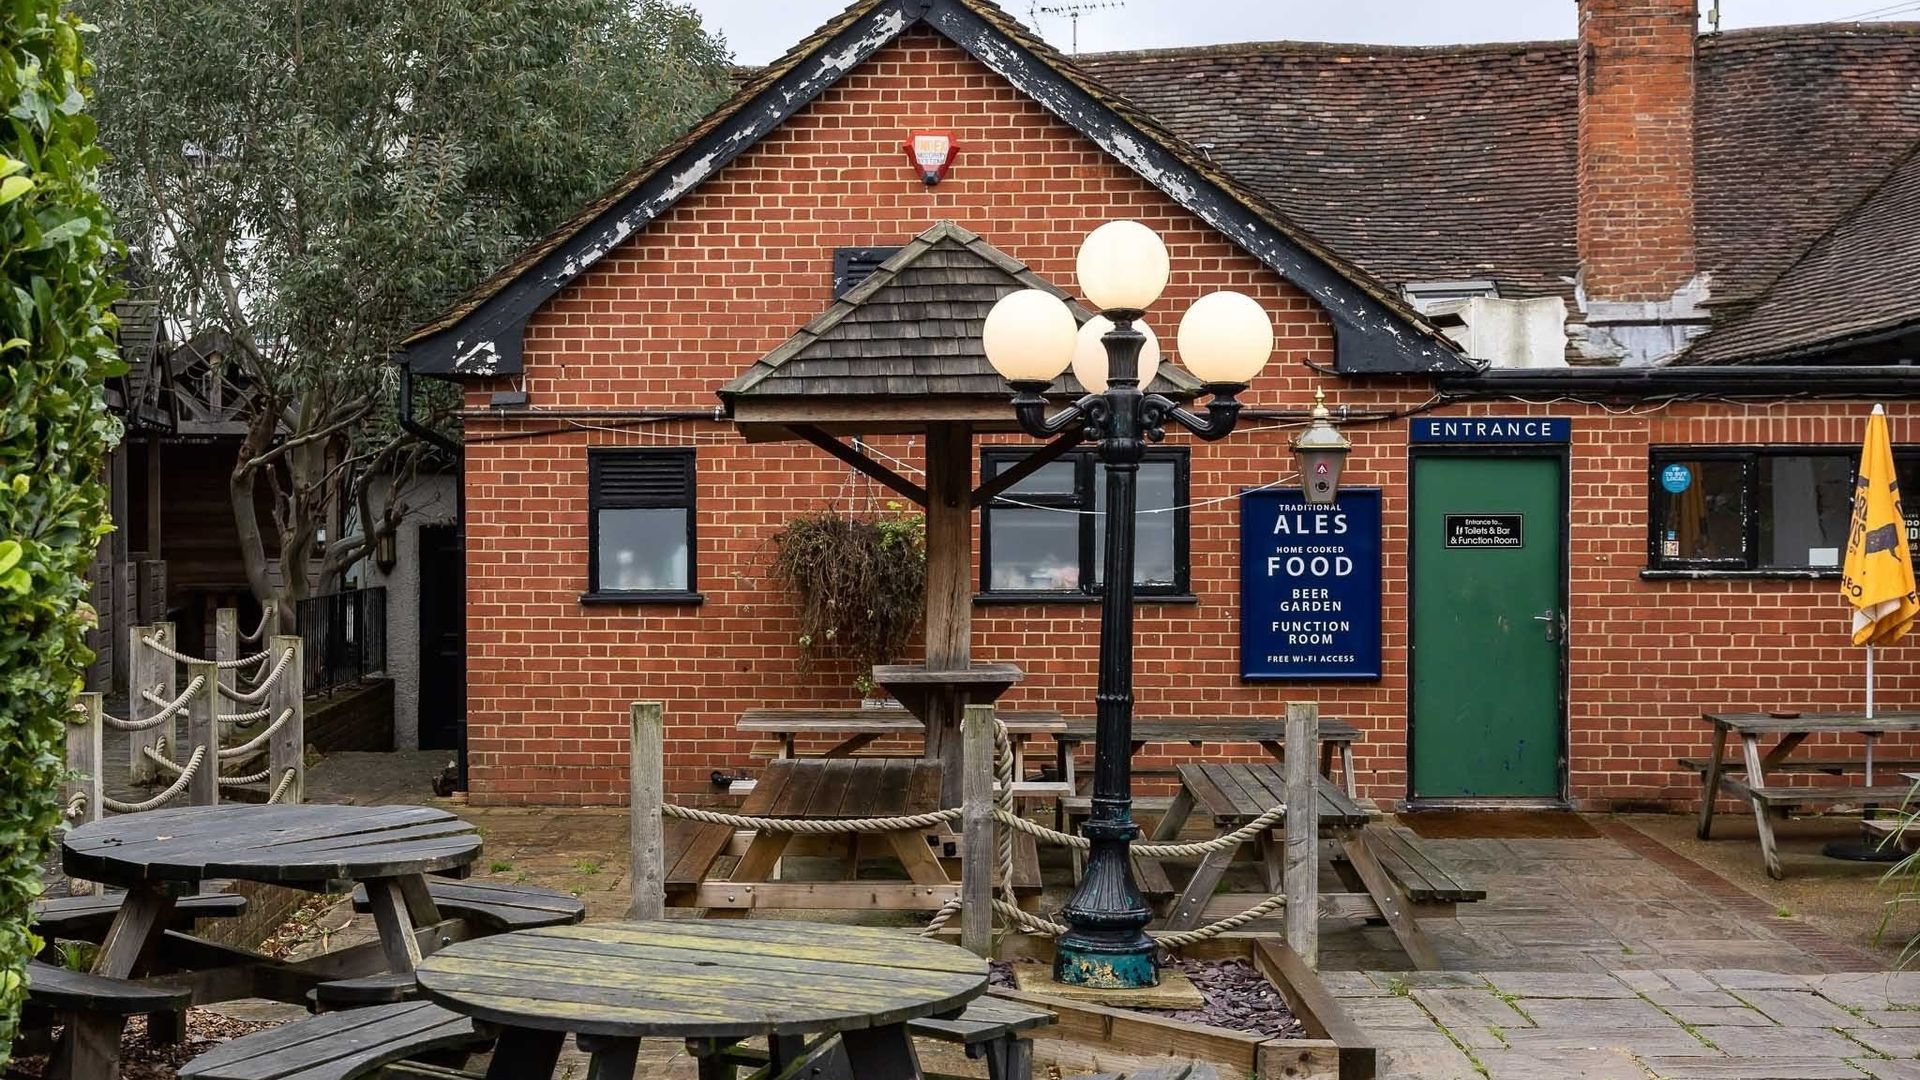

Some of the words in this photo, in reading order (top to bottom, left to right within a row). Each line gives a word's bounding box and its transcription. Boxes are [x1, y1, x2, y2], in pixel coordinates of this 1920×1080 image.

[1430, 422, 1551, 436] ENTRANCE
[1273, 514, 1348, 534] ALES
[1464, 526, 1488, 535] Toilets
[1488, 526, 1496, 535] &
[1496, 526, 1511, 535] Bar
[1450, 536, 1458, 545] &
[1458, 536, 1493, 545] Function
[1493, 536, 1519, 545] Room
[1267, 556, 1353, 576] FOOD
[1292, 588, 1329, 599] BEER
[1280, 601, 1342, 611] GARDEN
[1272, 621, 1350, 632] FUNCTION
[1289, 634, 1333, 644] ROOM
[1267, 655, 1289, 663] FREE
[1292, 655, 1317, 663] WI-FI
[1320, 655, 1355, 663] ACCESS
